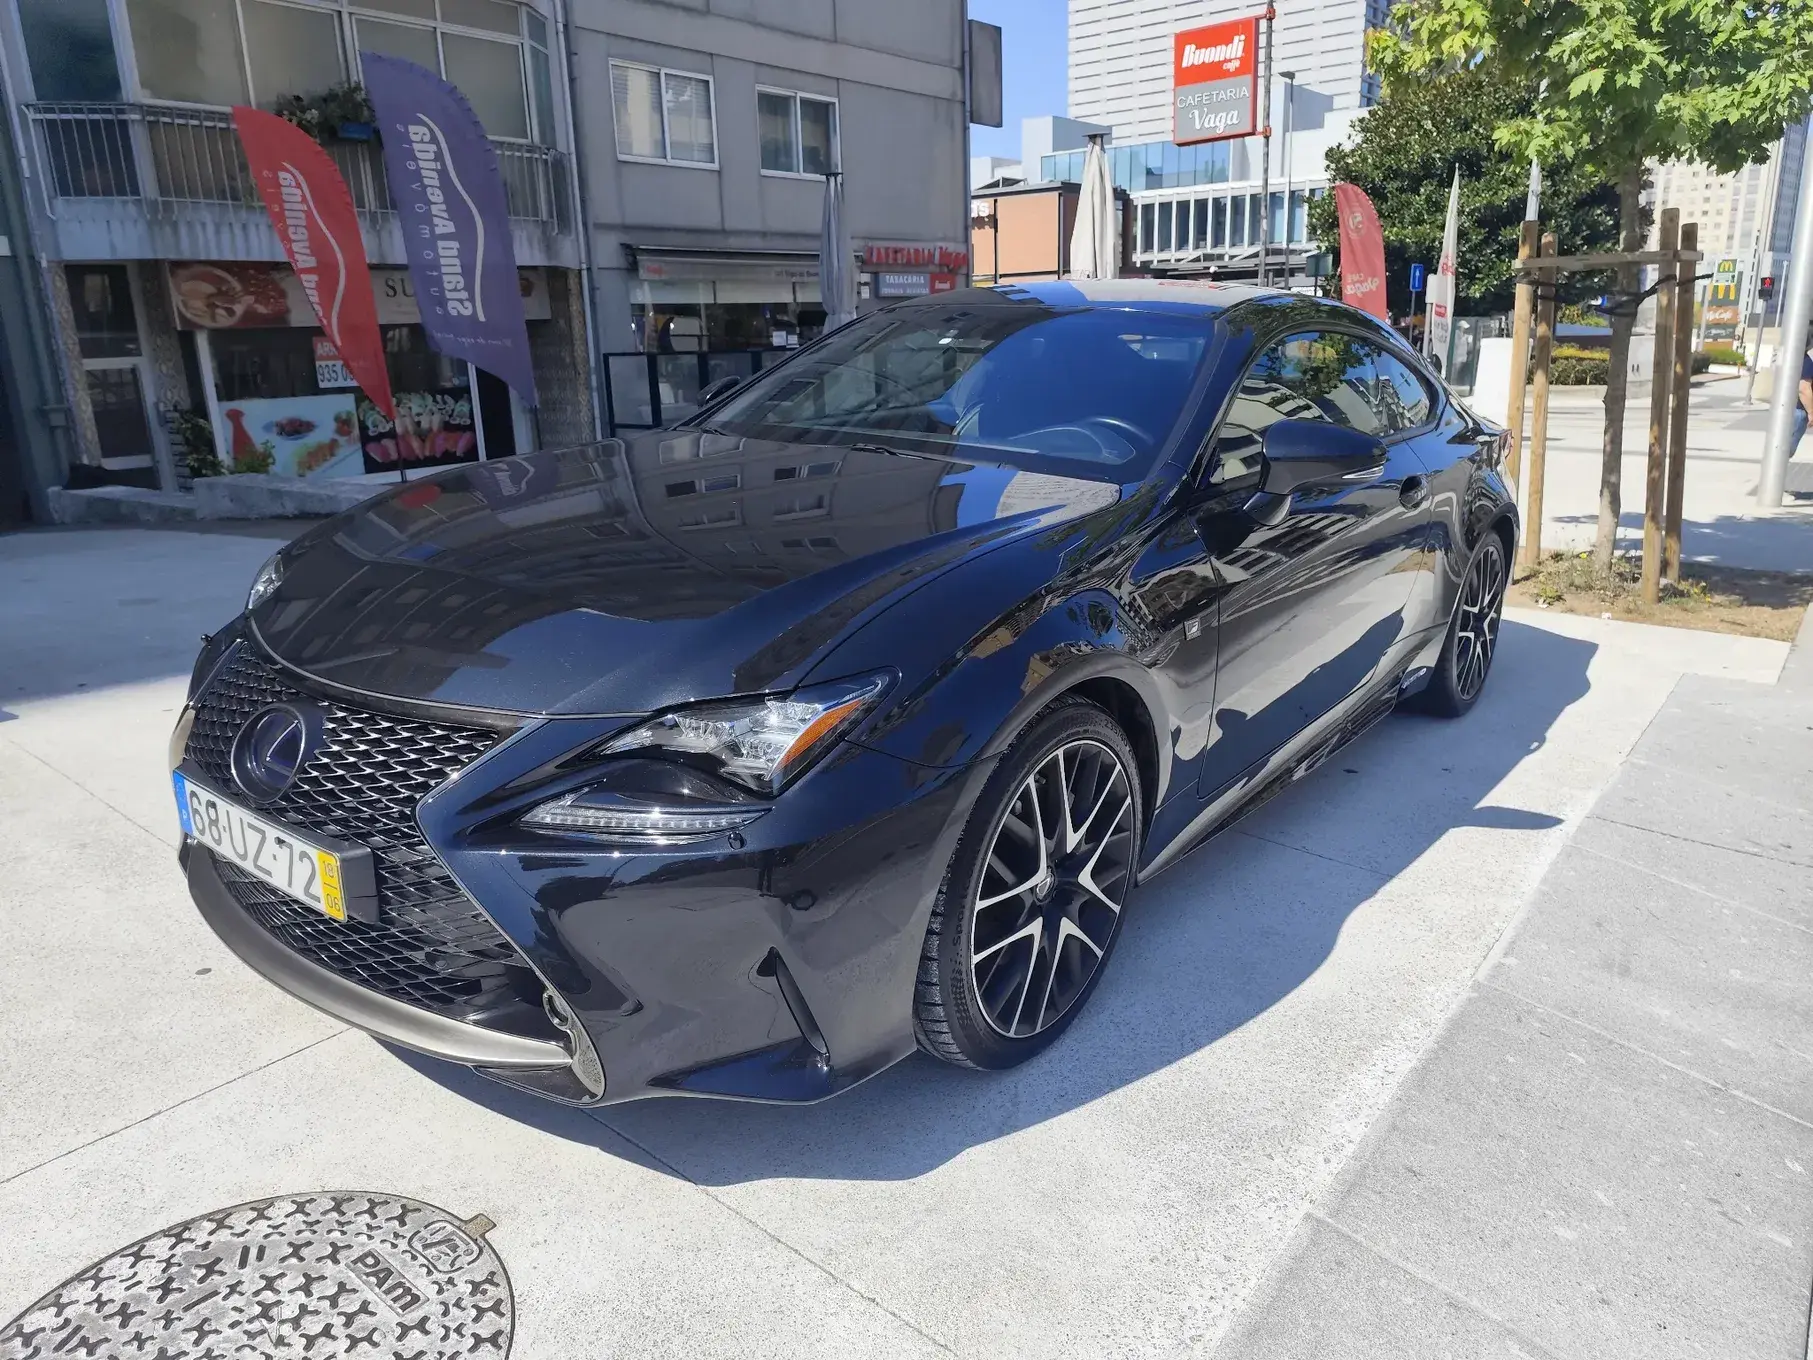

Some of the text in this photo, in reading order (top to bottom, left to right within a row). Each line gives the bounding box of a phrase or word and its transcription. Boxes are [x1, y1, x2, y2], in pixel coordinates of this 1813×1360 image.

[1181, 34, 1245, 68] Buondi
[1177, 86, 1249, 107] CAFETARIA
[1189, 108, 1240, 134] Vaga
[318, 364, 339, 382] 935
[326, 893, 341, 912] 06
